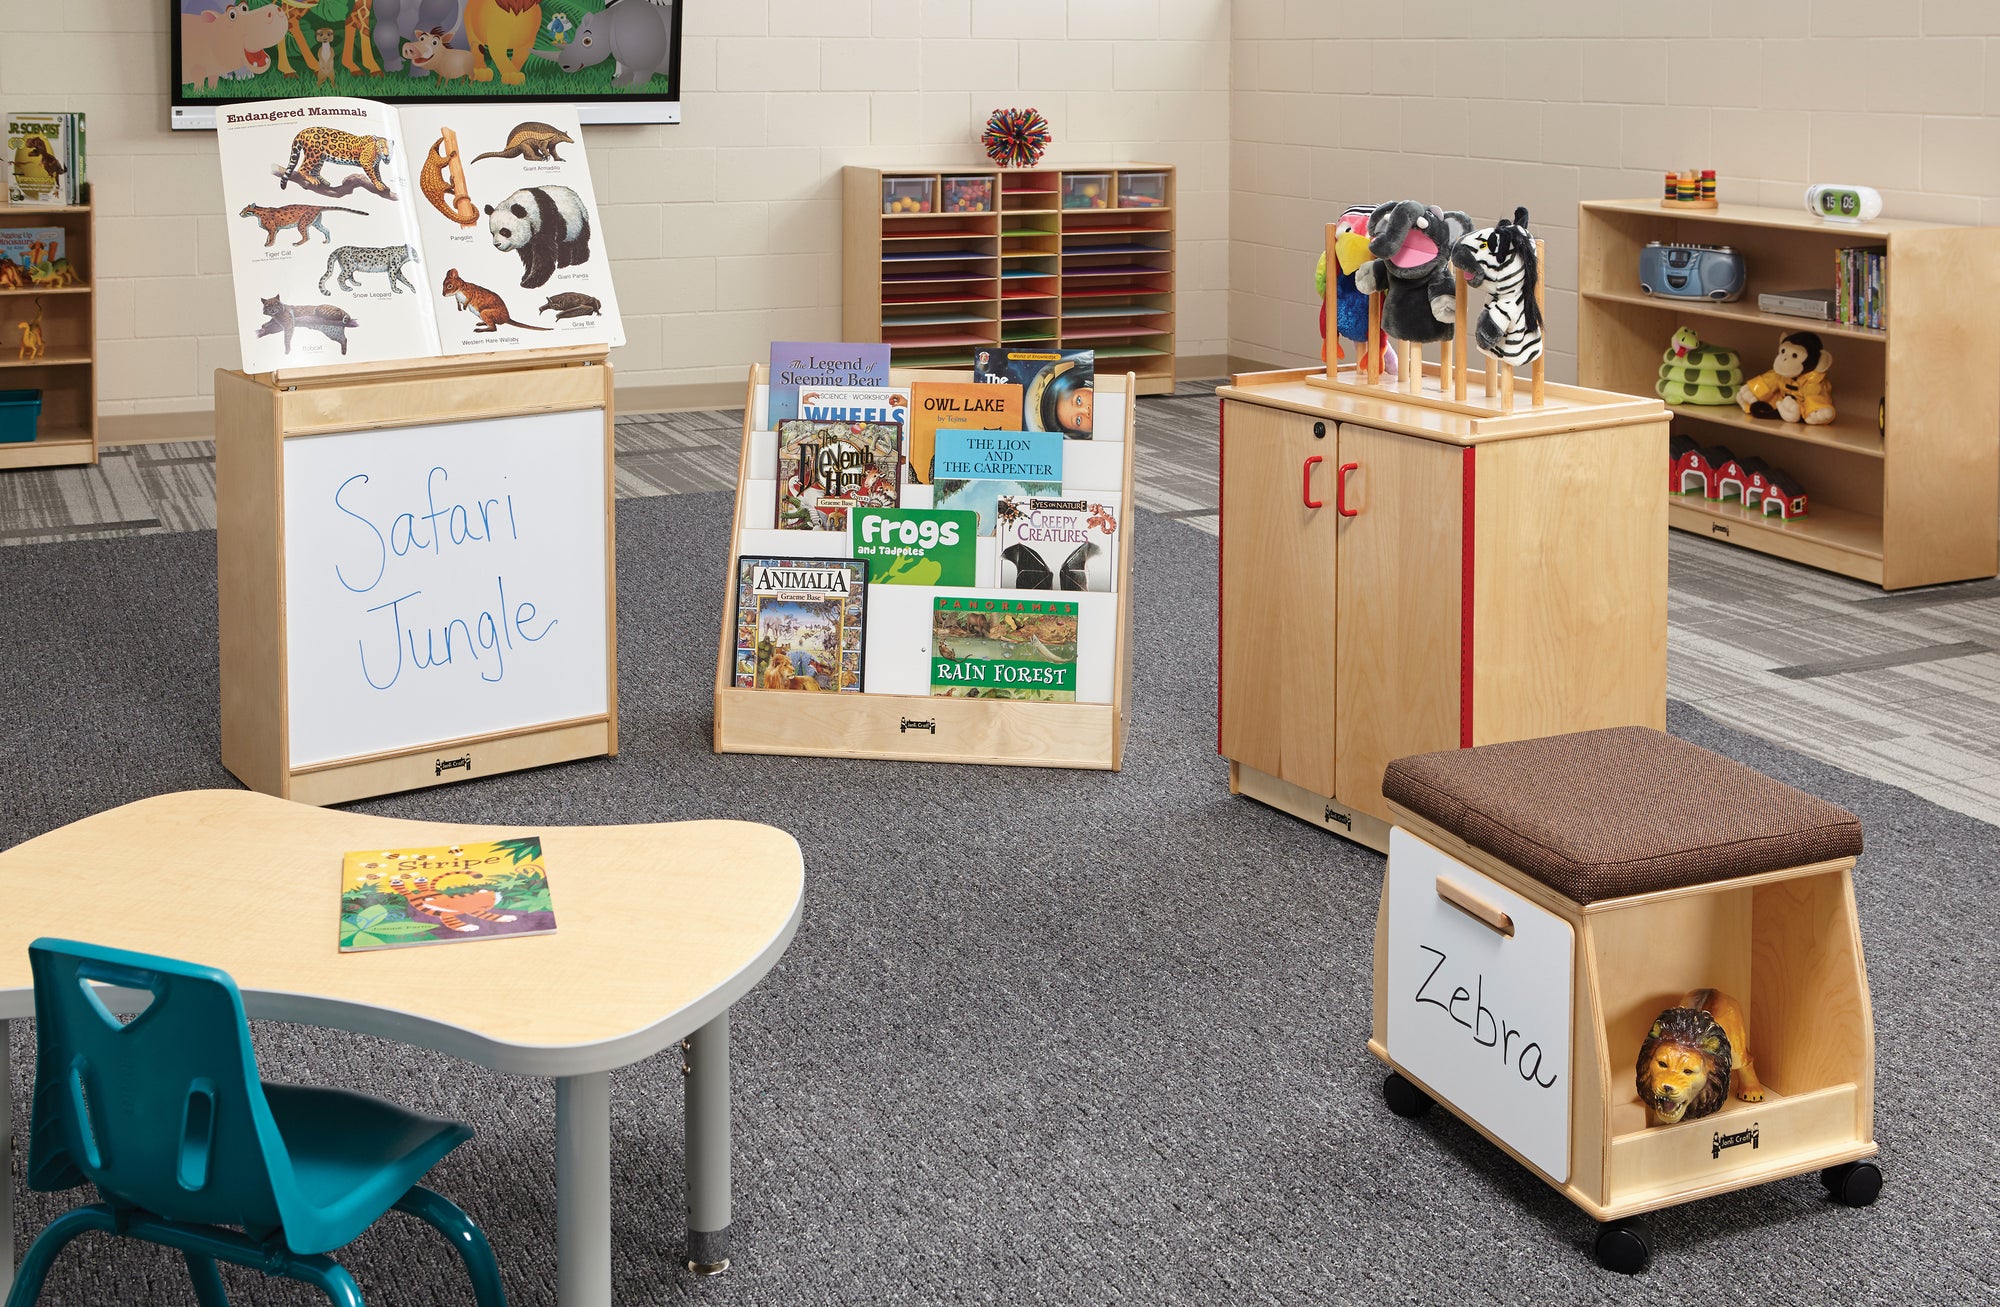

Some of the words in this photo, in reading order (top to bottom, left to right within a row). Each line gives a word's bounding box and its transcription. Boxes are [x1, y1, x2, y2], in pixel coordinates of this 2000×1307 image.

[226, 107, 306, 125] Endangered
[308, 107, 367, 118] Mammals
[1826, 196, 1836, 208] 15
[1843, 195, 1854, 208] 09
[450, 234, 473, 242] Pangolin
[265, 251, 280, 259] Tiger
[370, 291, 392, 299] Leopard
[572, 321, 586, 329] Gray
[499, 337, 520, 345] Wallaby
[788, 359, 807, 370] The
[809, 356, 862, 375] Legend
[864, 361, 878, 373] of
[780, 371, 843, 387] Sleeping
[847, 373, 882, 387] Bear
[984, 373, 1009, 385] The
[820, 392, 848, 401] SCIENCE
[852, 392, 890, 402] WORKSHOP
[924, 397, 960, 412] OWL
[964, 398, 1005, 413] LAKE
[937, 415, 945, 424] by
[947, 415, 968, 424] Tejima
[818, 429, 838, 448] The
[966, 437, 995, 450] THE
[998, 439, 1031, 451] LION
[985, 450, 1014, 462] AND
[1690, 455, 1699, 468] 3
[943, 461, 971, 474] THE
[974, 462, 1053, 476] CARPENTER
[1728, 463, 1736, 476] 4
[1753, 475, 1761, 487] 5
[1770, 486, 1778, 497] 6
[1030, 499, 1048, 511] EYES
[1056, 500, 1087, 512] NATURE
[1030, 510, 1078, 529] CREEPY
[335, 466, 517, 592] Safari
[861, 514, 960, 549] Frogs
[1018, 523, 1089, 544] CREATURES
[857, 546, 876, 555] and
[879, 545, 925, 557] Tadpoles
[754, 568, 849, 593] ANIMALIA
[780, 593, 806, 602] Graeme
[806, 593, 822, 602] Base
[939, 598, 1072, 614] PANORAMAS
[359, 576, 558, 690] Jungle
[937, 662, 987, 682] RAIN
[993, 664, 1067, 685] FOREST
[397, 854, 501, 872] Stripe
[1414, 943, 1558, 1089] Zebra
